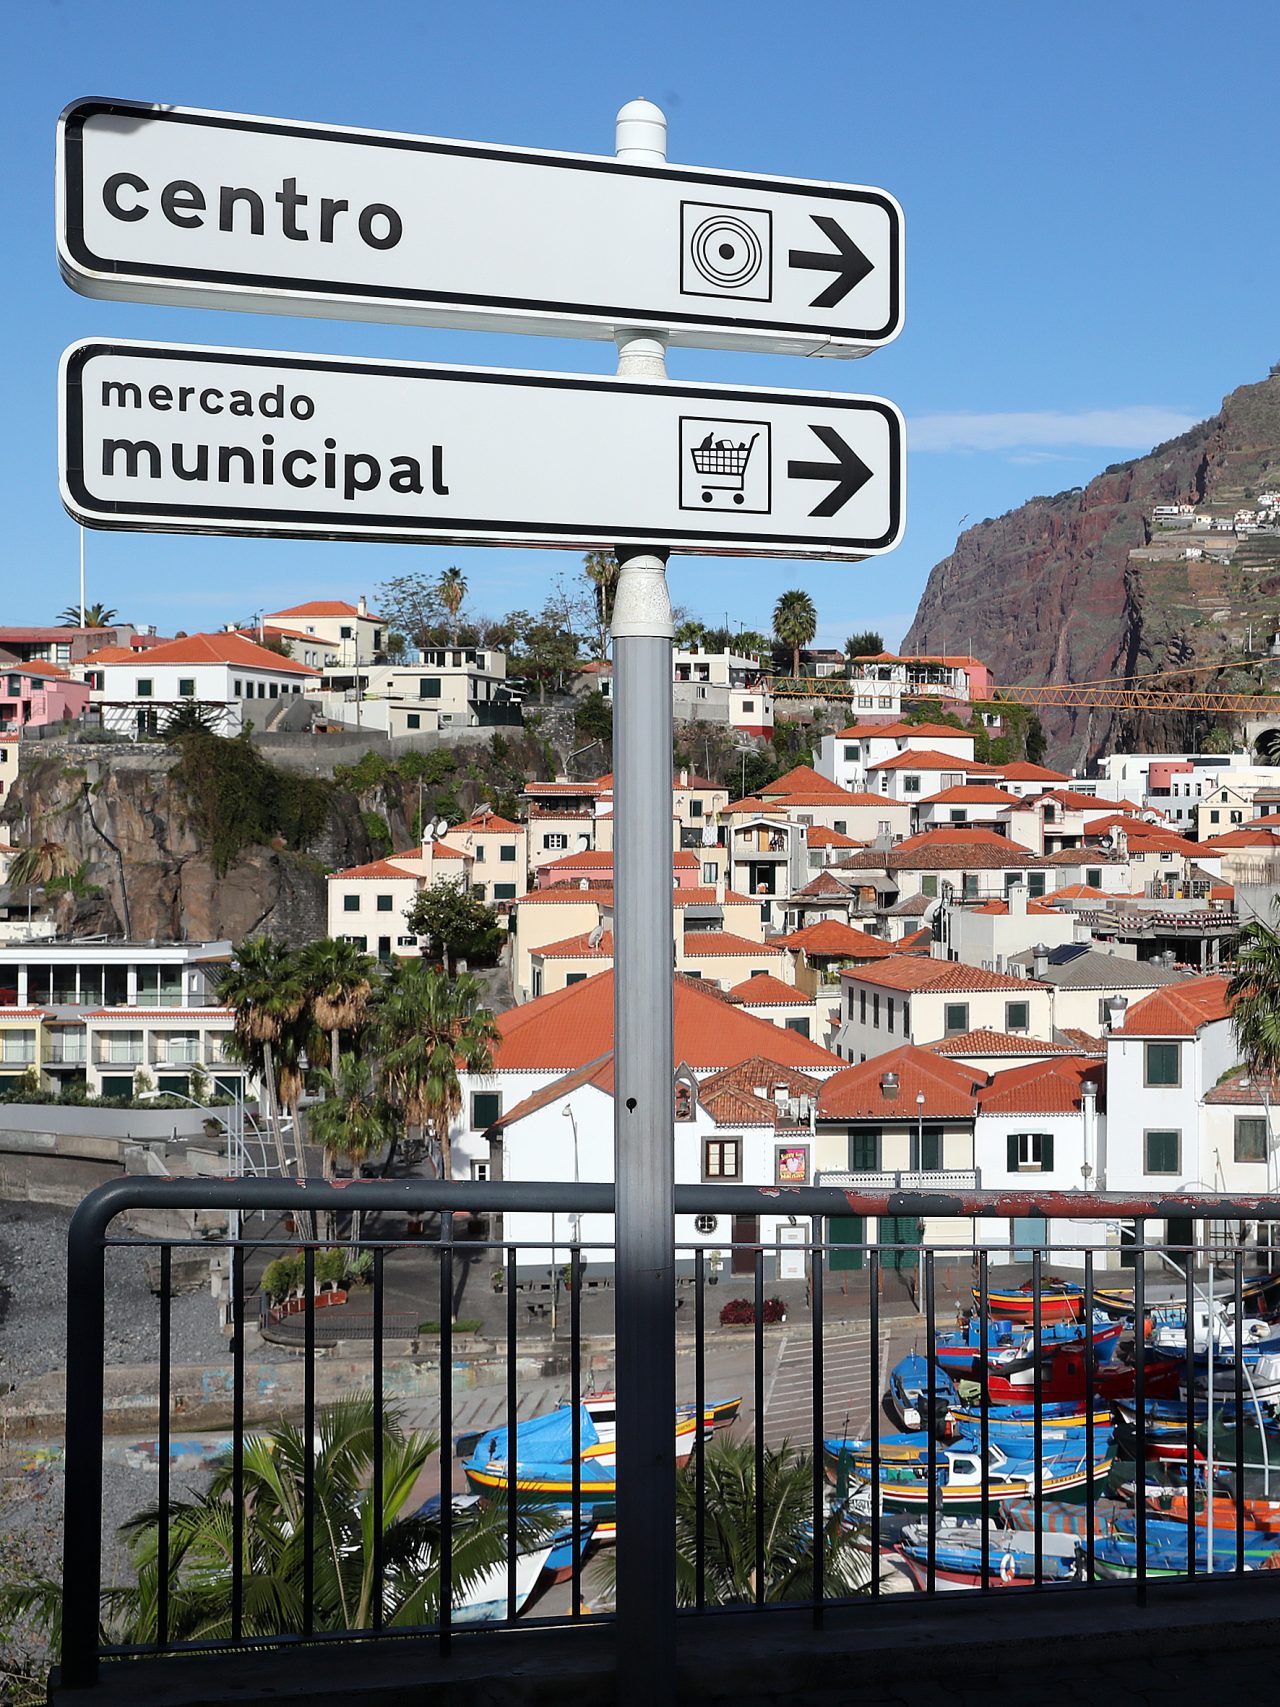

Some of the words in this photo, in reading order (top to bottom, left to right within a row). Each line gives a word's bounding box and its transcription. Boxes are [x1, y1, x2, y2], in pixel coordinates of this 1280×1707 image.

[103, 173, 402, 250] centro
[102, 381, 315, 420] mercado
[103, 434, 450, 500] municipal
